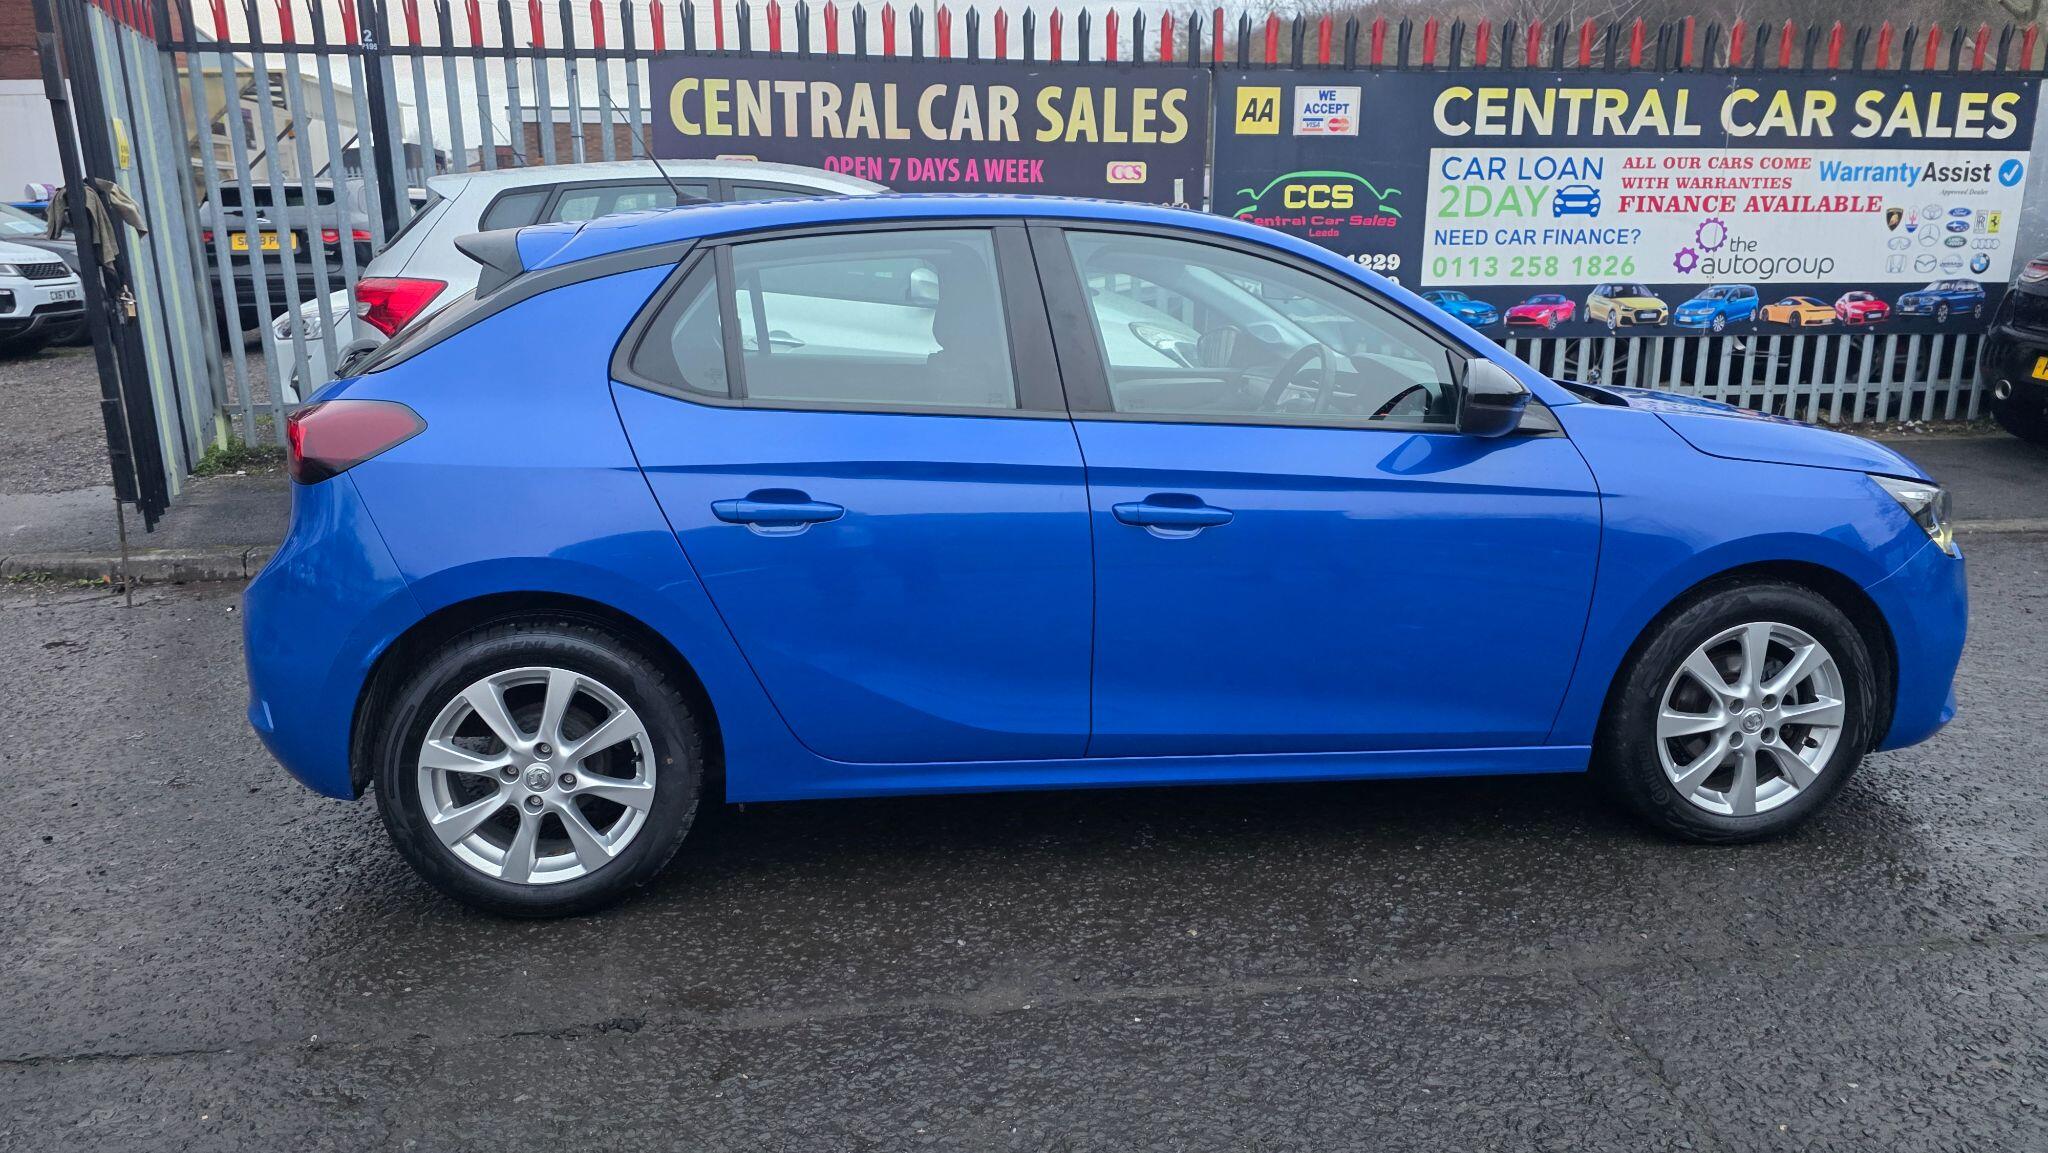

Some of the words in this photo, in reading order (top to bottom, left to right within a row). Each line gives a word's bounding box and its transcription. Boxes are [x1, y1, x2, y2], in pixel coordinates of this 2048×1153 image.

[363, 29, 373, 42] 2
[1318, 90, 1337, 101] WE
[670, 77, 910, 140] CENTRAL
[917, 83, 1020, 142] CAR
[1035, 85, 1189, 144] SALES
[1241, 97, 1274, 122] AA
[1303, 103, 1350, 115] ACCEPT
[1433, 86, 1701, 137] CENTRAL
[1720, 88, 1837, 137] CAR
[1850, 89, 2021, 140] SALES
[824, 155, 883, 181] OPEN
[888, 158, 902, 181] 7
[907, 157, 961, 182] DAYS
[964, 158, 980, 183] A
[983, 159, 1045, 183] WEEK
[1111, 165, 1142, 180] CCS
[1441, 156, 1507, 181] CAR
[1518, 156, 1603, 181] LOAN
[1622, 157, 1657, 169] ALL
[1663, 157, 1702, 169] OUR
[1707, 157, 1754, 170] CARS
[1759, 157, 1812, 170] COME
[1621, 177, 1670, 189] WITH
[1675, 177, 1793, 190] WARRANTIES
[1284, 185, 1353, 209] CCS
[1437, 185, 1550, 218] 2DAY
[1618, 195, 1736, 213] FINANCE
[1743, 196, 1883, 213] AVAILABLE
[1310, 215, 1345, 226] Car
[1349, 214, 1397, 227] Sales
[1308, 228, 1340, 237] Leeds
[1434, 229, 1488, 246] NEED
[1495, 229, 1536, 245] CAR
[1542, 228, 1642, 245] FINANCE?
[1730, 236, 1758, 252] the
[1432, 256, 1498, 278] 0113
[1510, 256, 1559, 277] 258
[1572, 255, 1636, 276] 1826
[1701, 254, 1835, 280] autogroup
